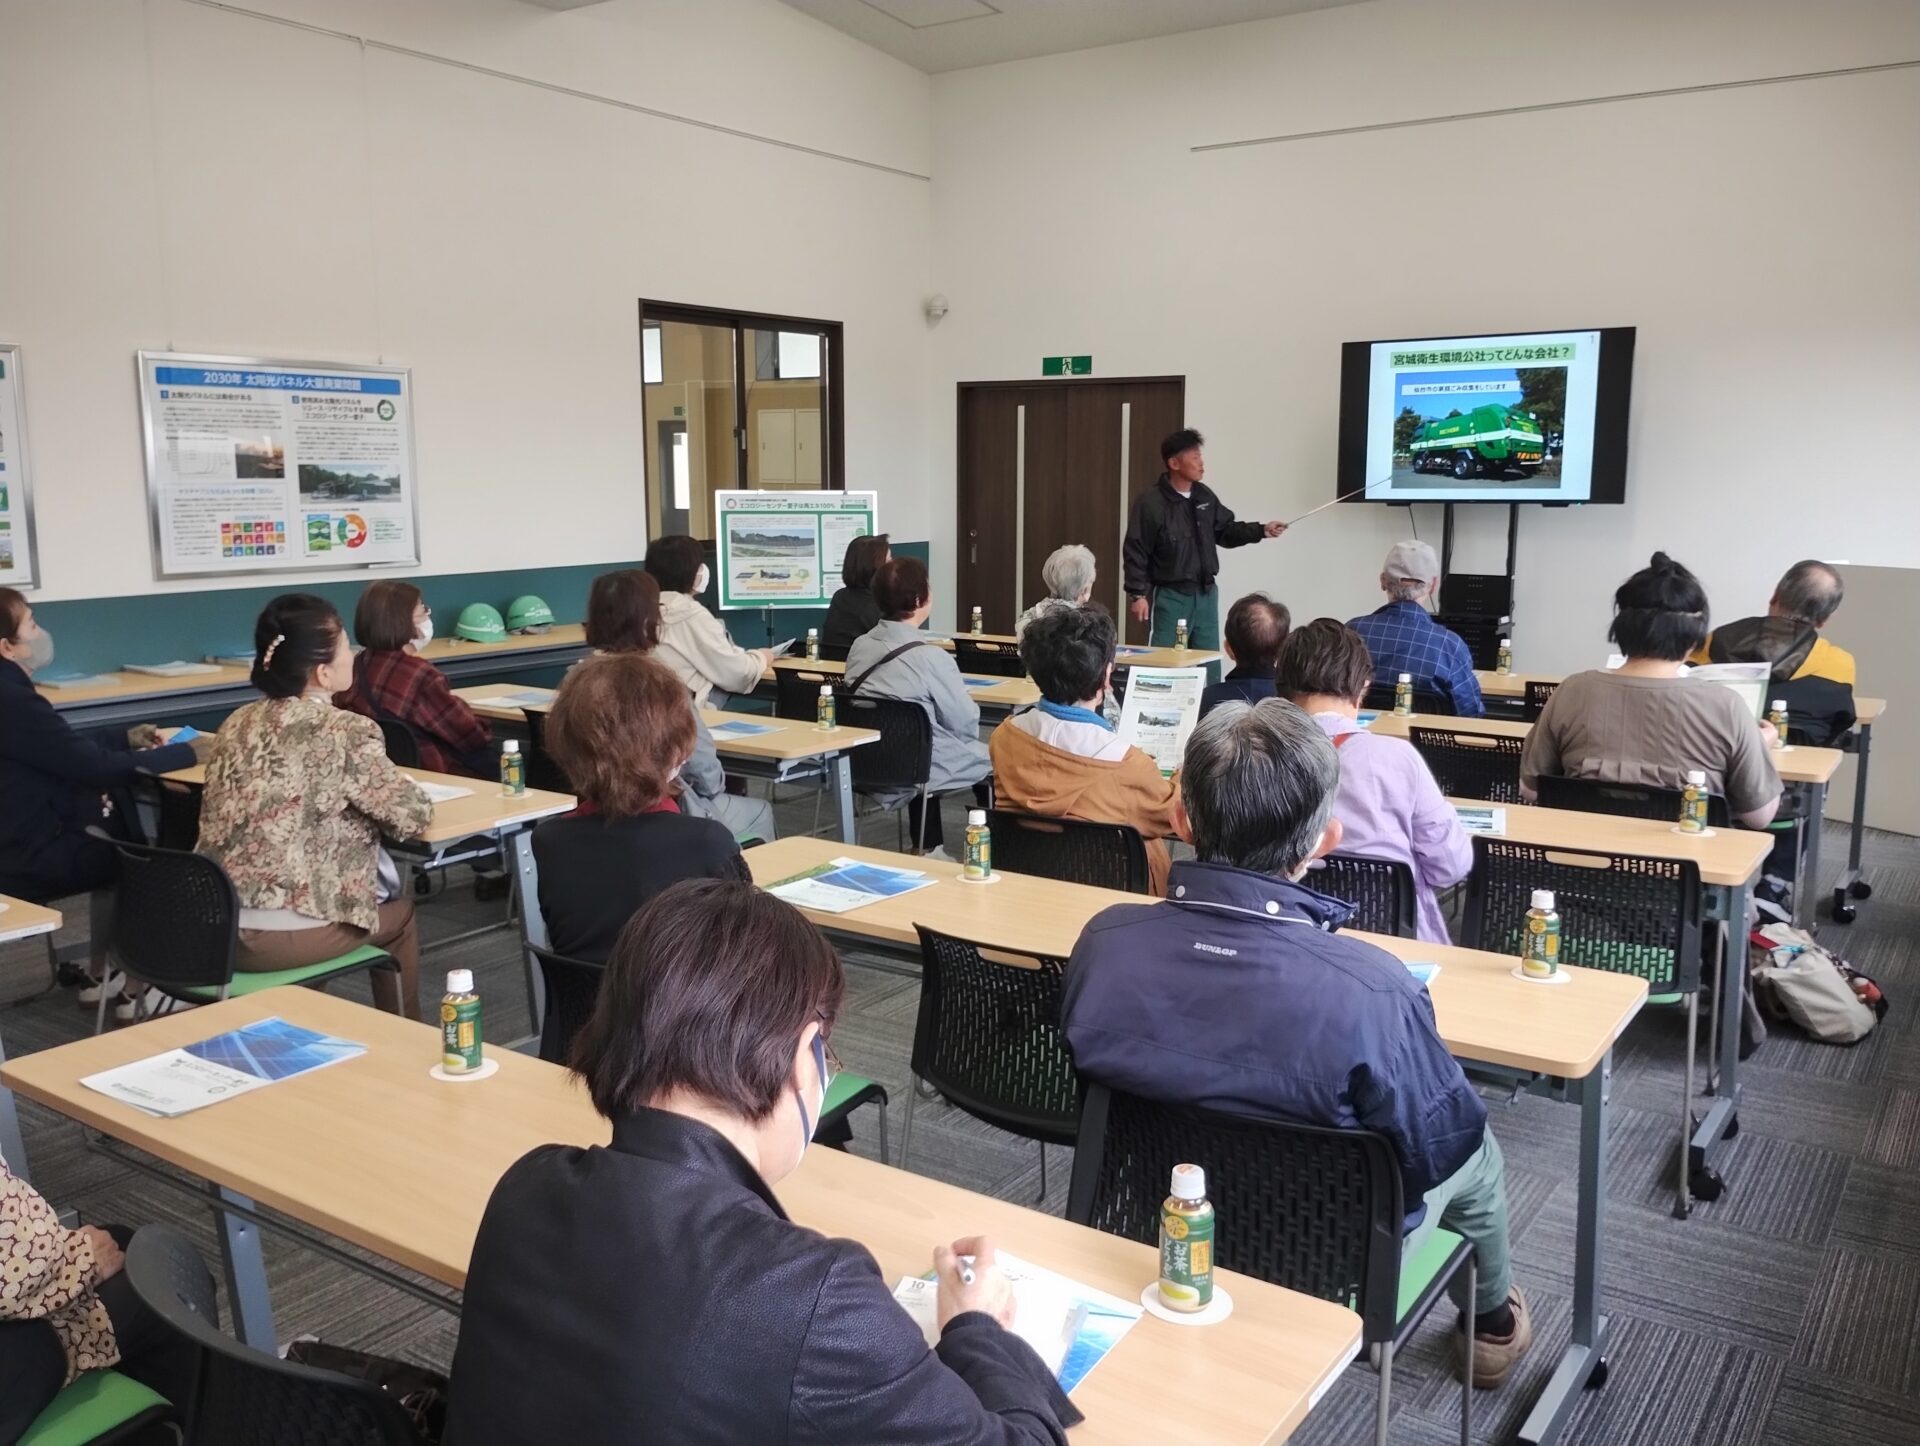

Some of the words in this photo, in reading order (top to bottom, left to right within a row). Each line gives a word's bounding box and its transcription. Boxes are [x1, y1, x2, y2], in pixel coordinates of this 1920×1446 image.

[1393, 346, 1570, 366] 宮城衛生環境公社ってどんな会社？
[203, 372, 243, 385] 2030年
[1193, 942, 1238, 956] DUNLOP
